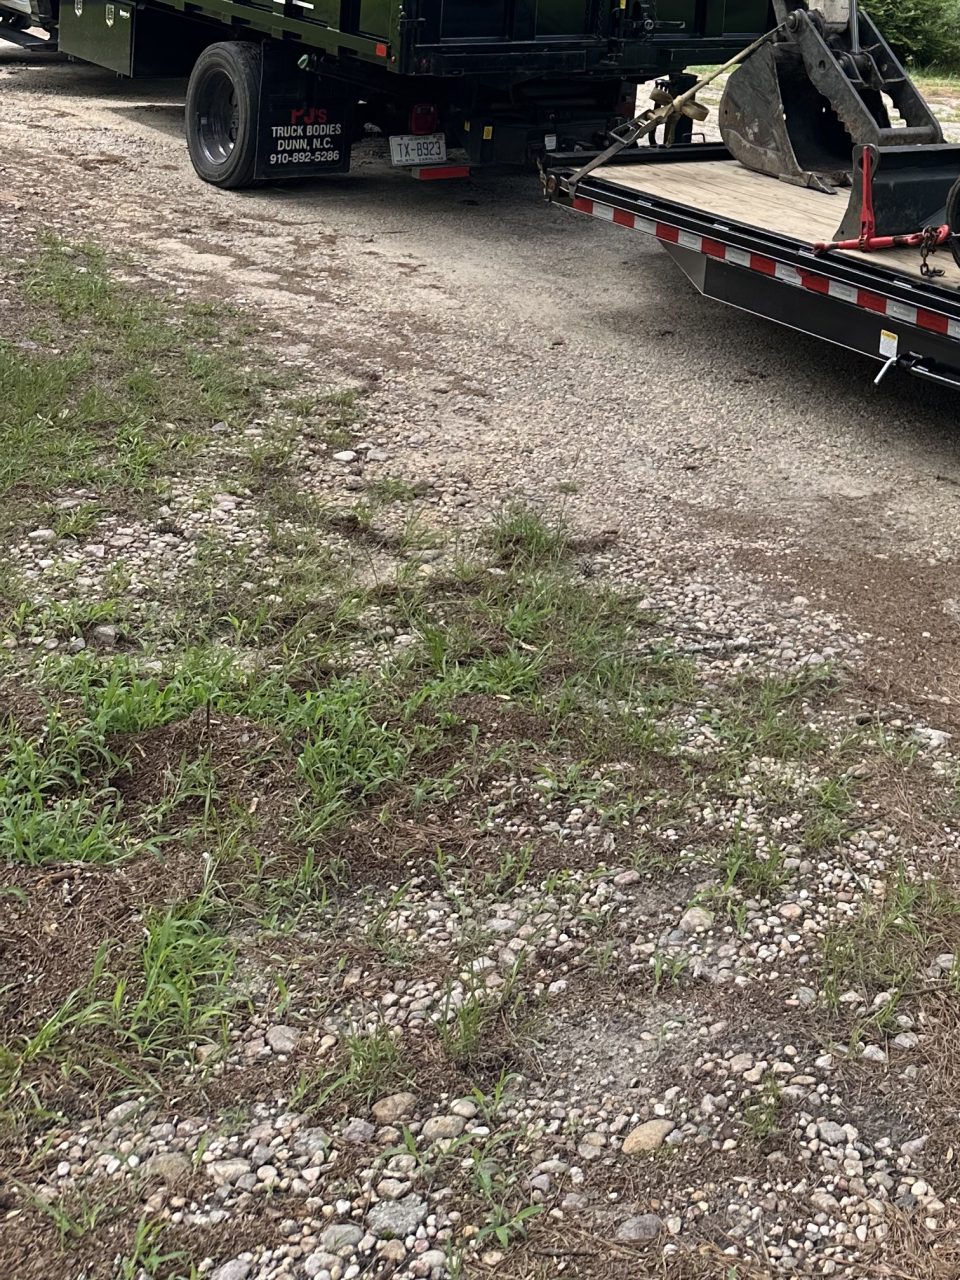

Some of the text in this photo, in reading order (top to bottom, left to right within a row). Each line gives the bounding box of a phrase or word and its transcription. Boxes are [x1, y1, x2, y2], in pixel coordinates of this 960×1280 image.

[271, 123, 342, 138] TRUCK BODIES
[277, 137, 334, 151] DUNN, N.C.
[270, 150, 340, 165] 910-892-5286
